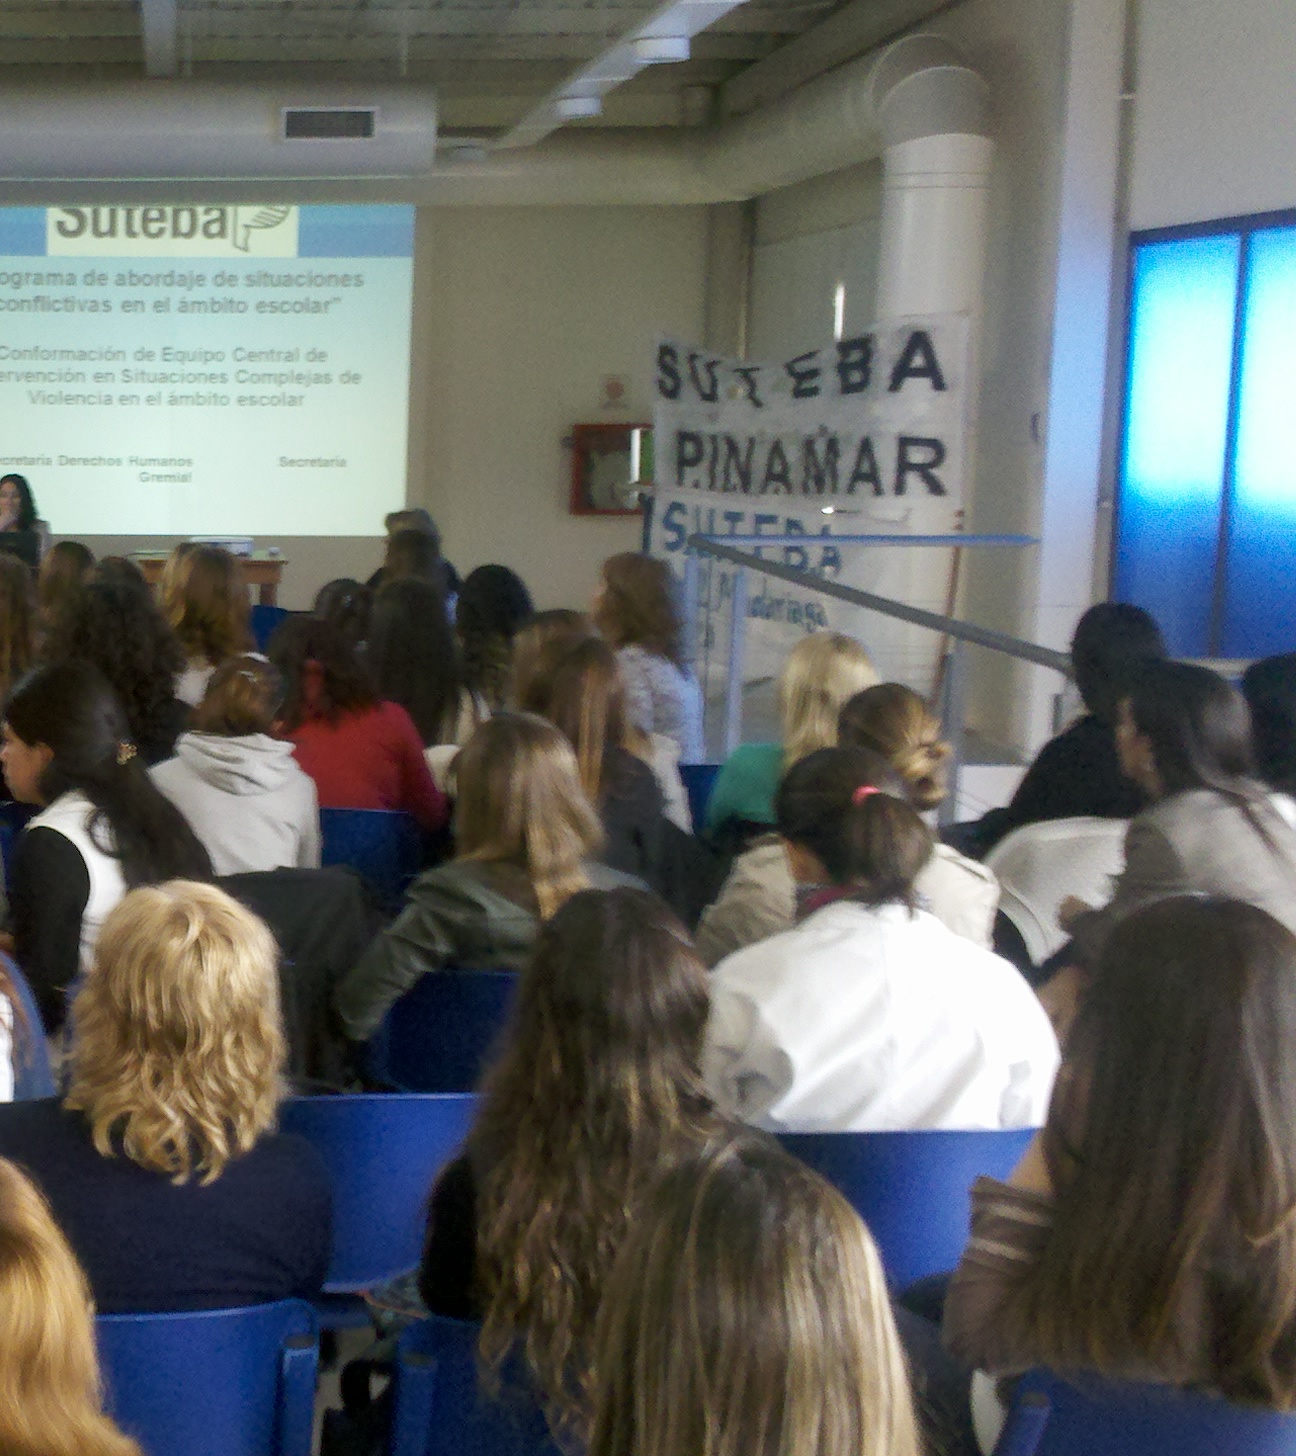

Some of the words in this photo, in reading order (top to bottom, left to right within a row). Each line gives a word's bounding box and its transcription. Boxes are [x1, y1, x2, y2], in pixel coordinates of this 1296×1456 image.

[83, 267, 107, 288] de
[114, 267, 207, 291] abordaje
[213, 268, 238, 288] de
[245, 268, 364, 288] situaciones
[120, 298, 145, 313] en
[152, 294, 170, 313] el
[177, 294, 248, 313] ámbito
[134, 346, 155, 363] de
[161, 346, 225, 365] Equipo
[232, 346, 299, 363] Central
[306, 346, 327, 363] de
[94, 371, 115, 384] en
[121, 368, 229, 385] Situaciones
[234, 368, 333, 387] Complejas
[339, 369, 361, 386] de
[657, 330, 947, 408] SUTEBA
[29, 391, 113, 406] Violencia
[118, 394, 140, 406] en
[146, 390, 162, 406] el
[168, 390, 230, 407] ámbito
[236, 390, 304, 407] escolar
[58, 454, 123, 467] Derechos
[129, 455, 193, 468] Humanos
[676, 430, 946, 496] PINAMAR
